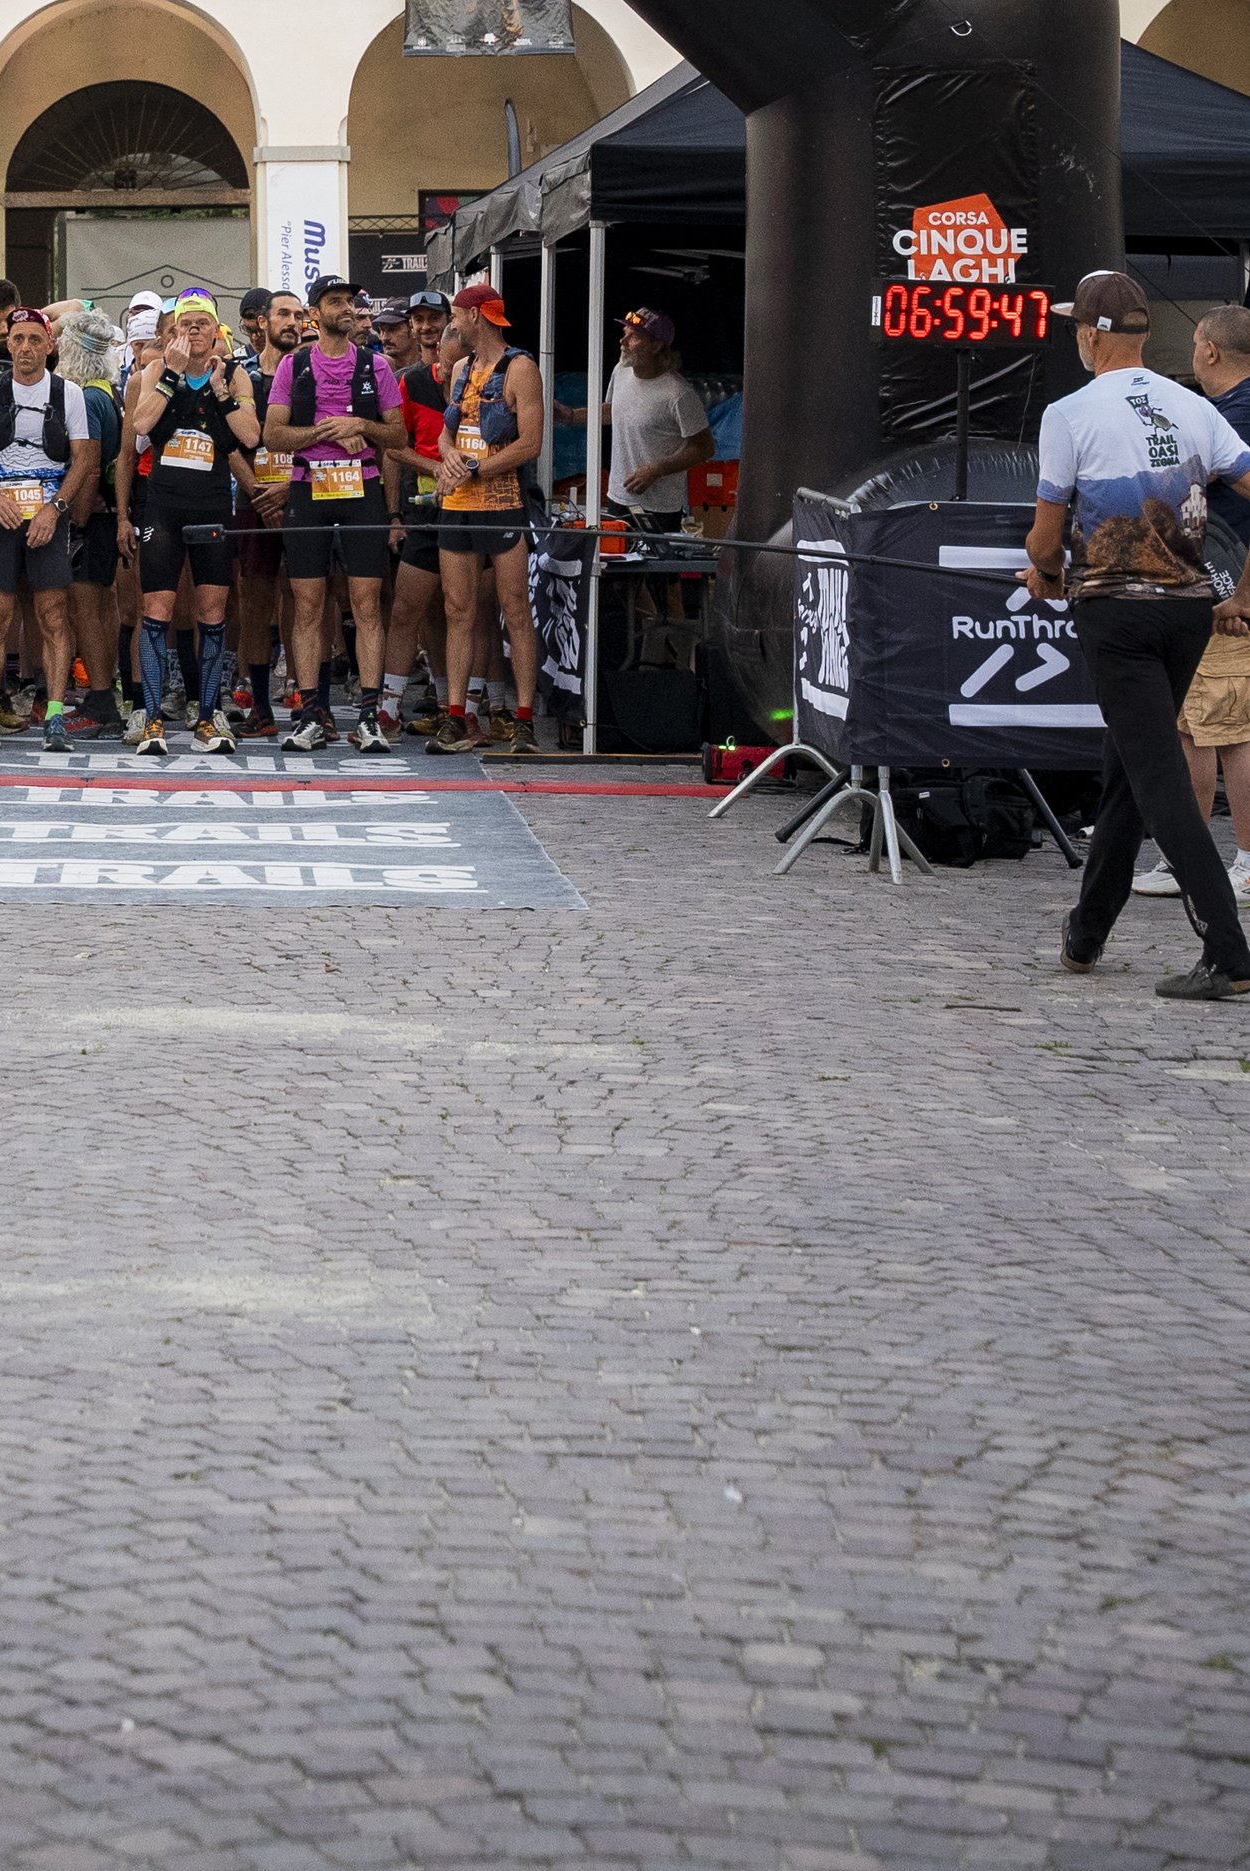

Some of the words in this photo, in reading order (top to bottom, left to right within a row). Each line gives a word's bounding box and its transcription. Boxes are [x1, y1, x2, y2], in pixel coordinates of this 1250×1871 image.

[928, 211, 989, 225] CORSA
[892, 228, 1028, 256] CINQUE
[907, 258, 1016, 283] LAGHI
[884, 285, 1048, 340] 06:59:47
[185, 438, 212, 453] 1147
[460, 437, 487, 450] 1160
[1145, 434, 1177, 446] TRAIL
[1149, 444, 1179, 458] OASI
[273, 453, 294, 464] 108
[331, 471, 360, 482] 1164
[13, 489, 41, 501] 1045
[27, 752, 412, 774] TRAILS
[0, 823, 448, 844] TRAILS
